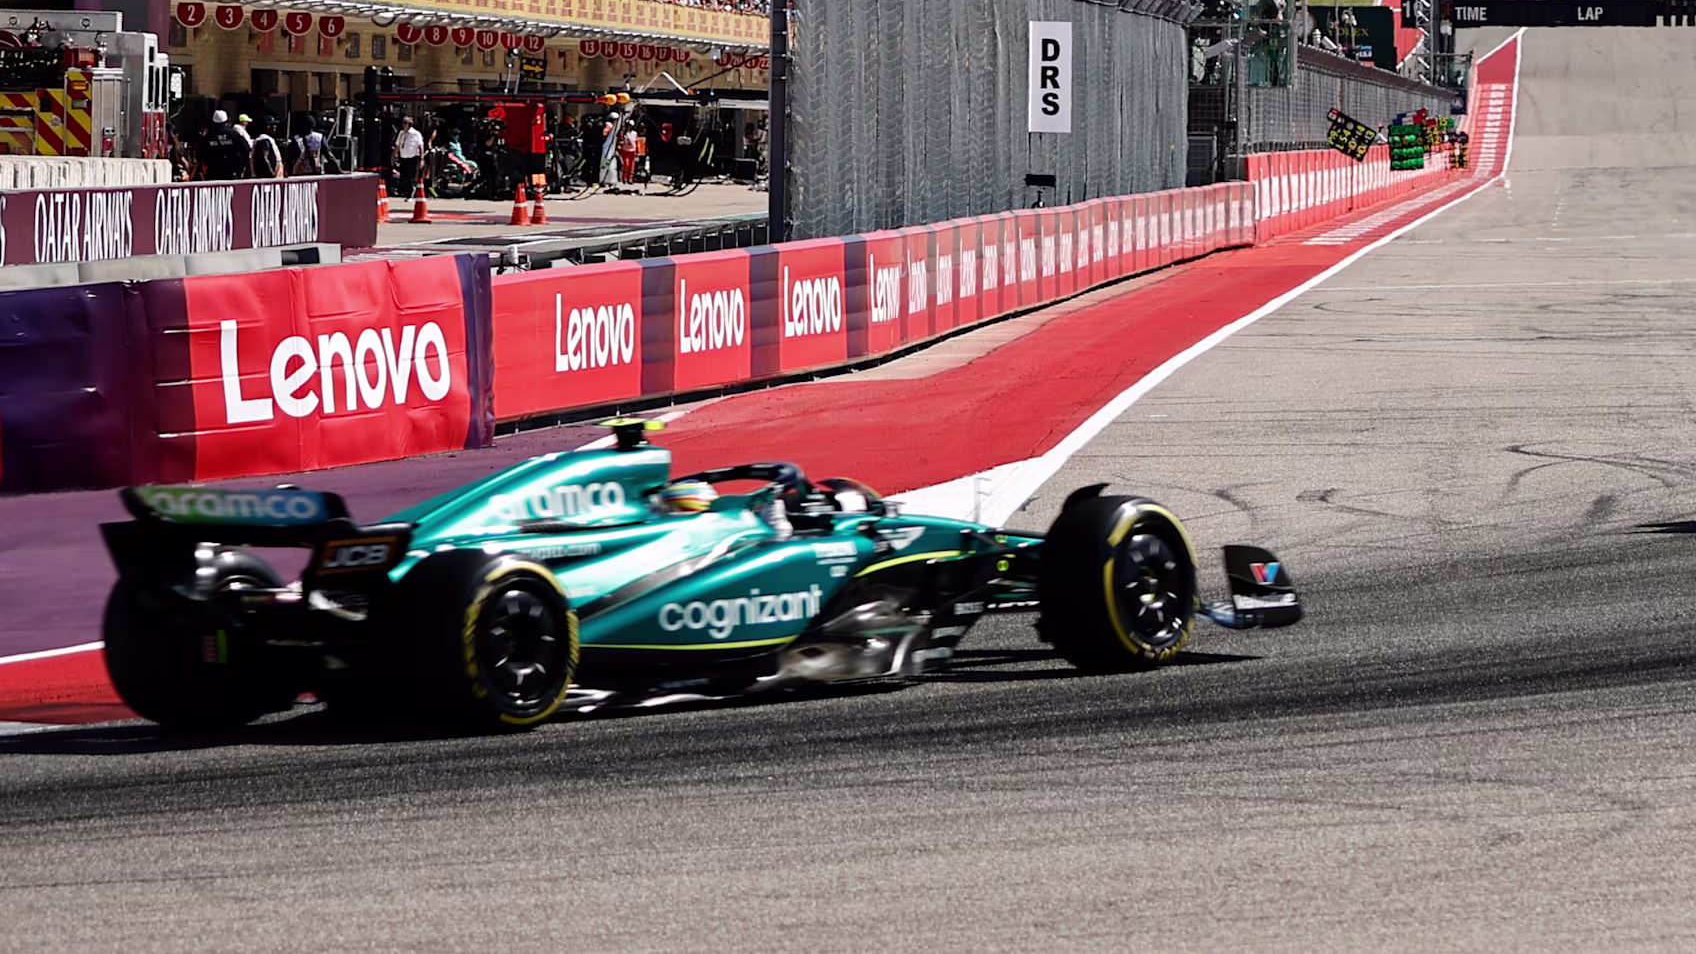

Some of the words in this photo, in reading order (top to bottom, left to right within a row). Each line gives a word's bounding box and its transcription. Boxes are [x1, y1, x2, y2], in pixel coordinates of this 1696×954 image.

[187, 4, 196, 22] 2
[225, 7, 234, 25] 3
[260, 11, 268, 27] 4
[295, 14, 304, 30] 5
[1455, 6, 1488, 21] TIME
[1577, 7, 1604, 22] LAP
[327, 18, 336, 34] 6
[406, 24, 413, 43] 7
[433, 27, 441, 42] 8
[459, 29, 466, 42] 9
[482, 32, 494, 46] 10
[529, 36, 540, 50] 12
[585, 41, 595, 54] 13
[604, 43, 614, 55] 14
[624, 44, 633, 57] 15
[1041, 38, 1060, 115] DRS
[155, 188, 190, 255] QATAR
[191, 185, 234, 252] AIRWAYS
[251, 184, 281, 248] QATAR
[282, 181, 318, 244] AIRWAYS
[34, 193, 82, 264] QATAR
[84, 191, 133, 262] AIRWAYS
[784, 266, 841, 337] Lenovo
[679, 278, 744, 353] Lenovo
[555, 292, 634, 372] Lenovo
[220, 319, 451, 424] Lenovo
[153, 491, 317, 519] aramco
[494, 481, 625, 520] aramco
[325, 545, 388, 567] JCB
[658, 584, 823, 639] cognizant
